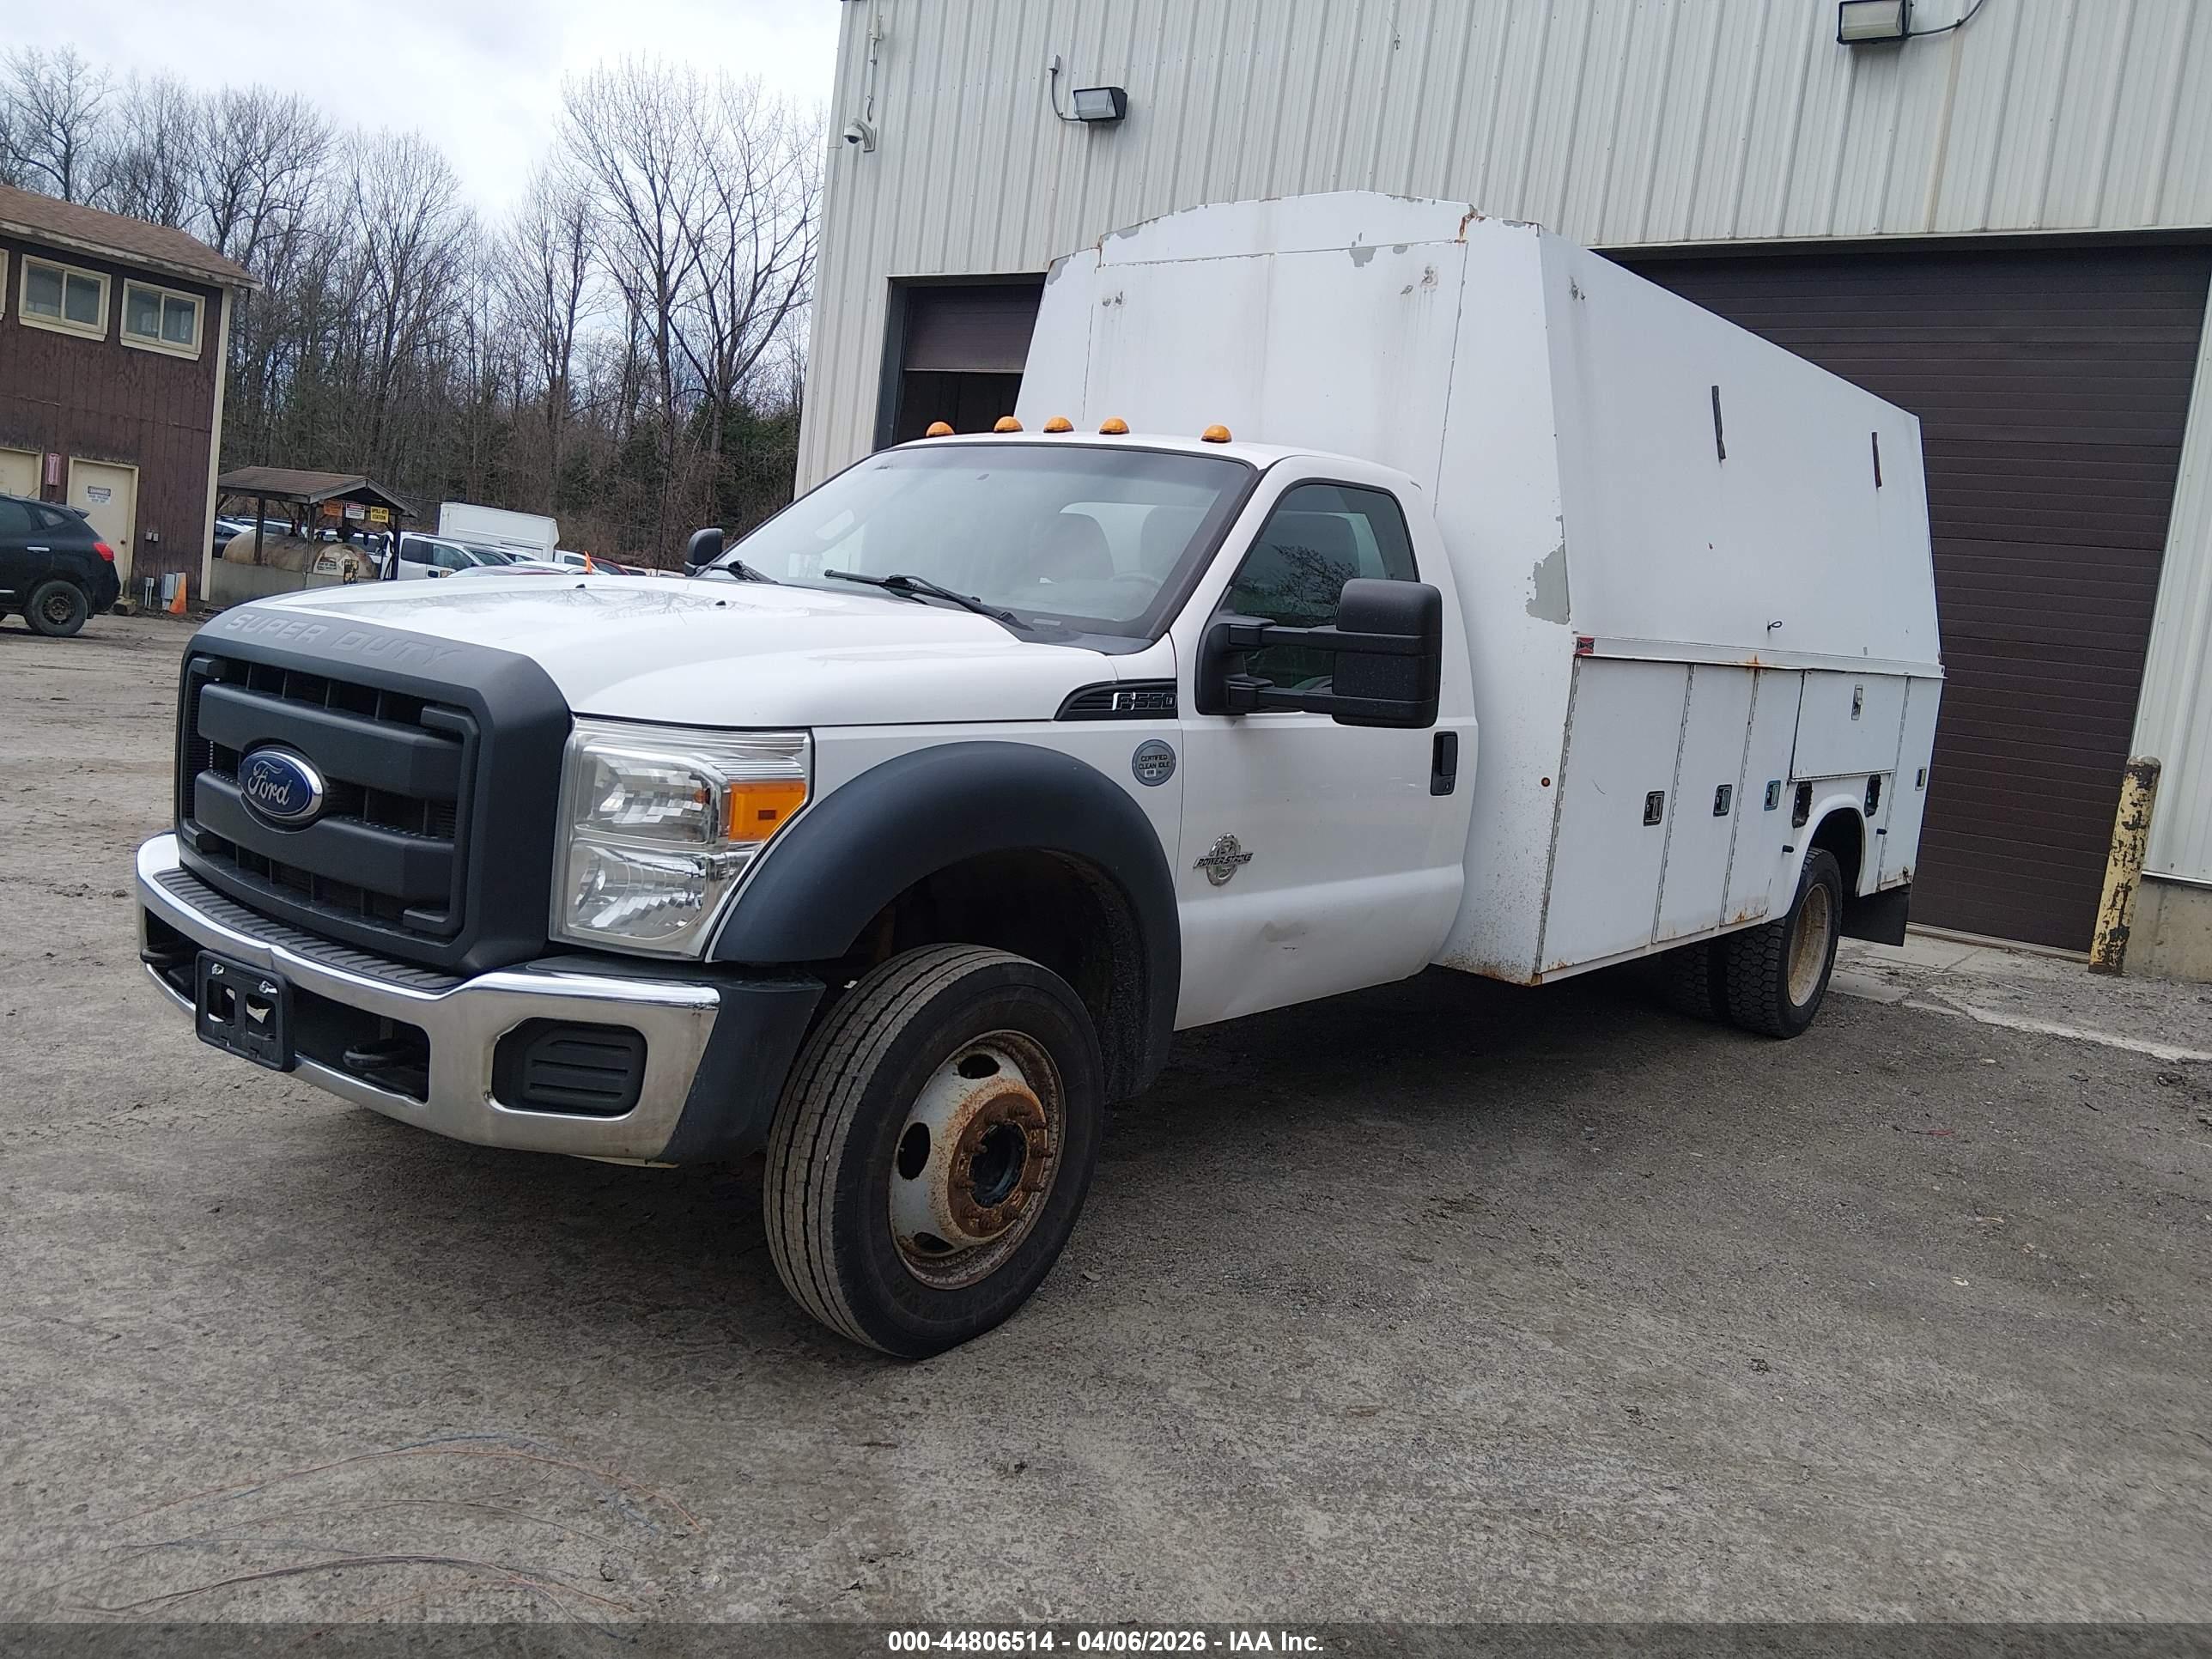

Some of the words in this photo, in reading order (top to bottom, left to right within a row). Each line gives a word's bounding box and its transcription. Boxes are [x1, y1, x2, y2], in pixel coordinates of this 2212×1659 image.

[225, 613, 330, 644] SUPER
[330, 629, 463, 666] DUTY
[247, 760, 293, 805] Ford
